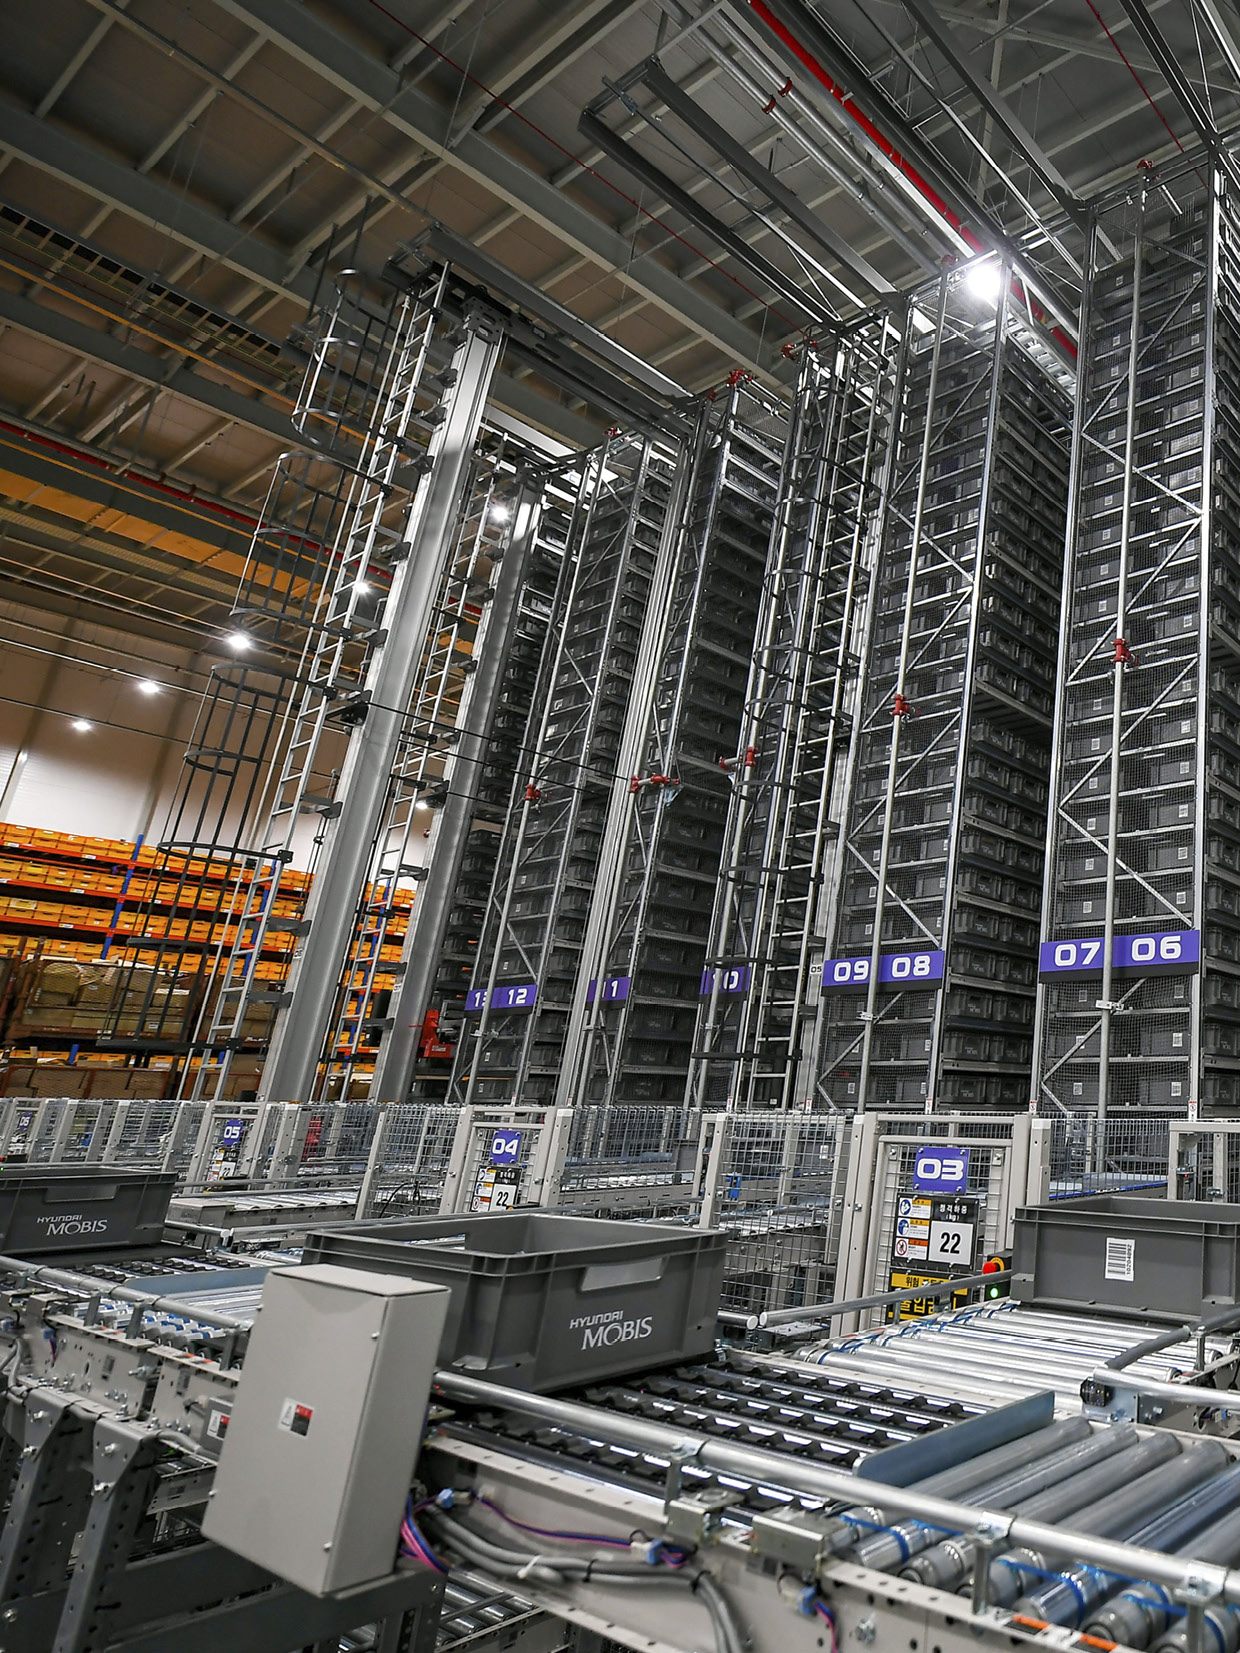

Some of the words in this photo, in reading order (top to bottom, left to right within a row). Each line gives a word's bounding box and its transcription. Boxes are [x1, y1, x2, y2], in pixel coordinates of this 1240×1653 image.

[1054, 941, 1101, 967] 07
[1131, 935, 1182, 962] 06
[810, 965, 822, 974] 05
[833, 960, 869, 982] 09
[891, 955, 931, 978] 08
[712, 970, 739, 990] 0
[508, 988, 528, 1005] 12
[223, 1126, 241, 1139] 05
[492, 1138, 519, 1156] 04
[917, 1158, 964, 1181] 03
[496, 1191, 509, 1206] 22
[36, 1214, 82, 1223] HYUNDAI
[46, 1219, 108, 1236] MOBIS
[939, 1232, 961, 1254] 22
[906, 1276, 919, 1288] 위험
[569, 1310, 624, 1330] HYUNDAI
[581, 1317, 653, 1350] MOBIS
